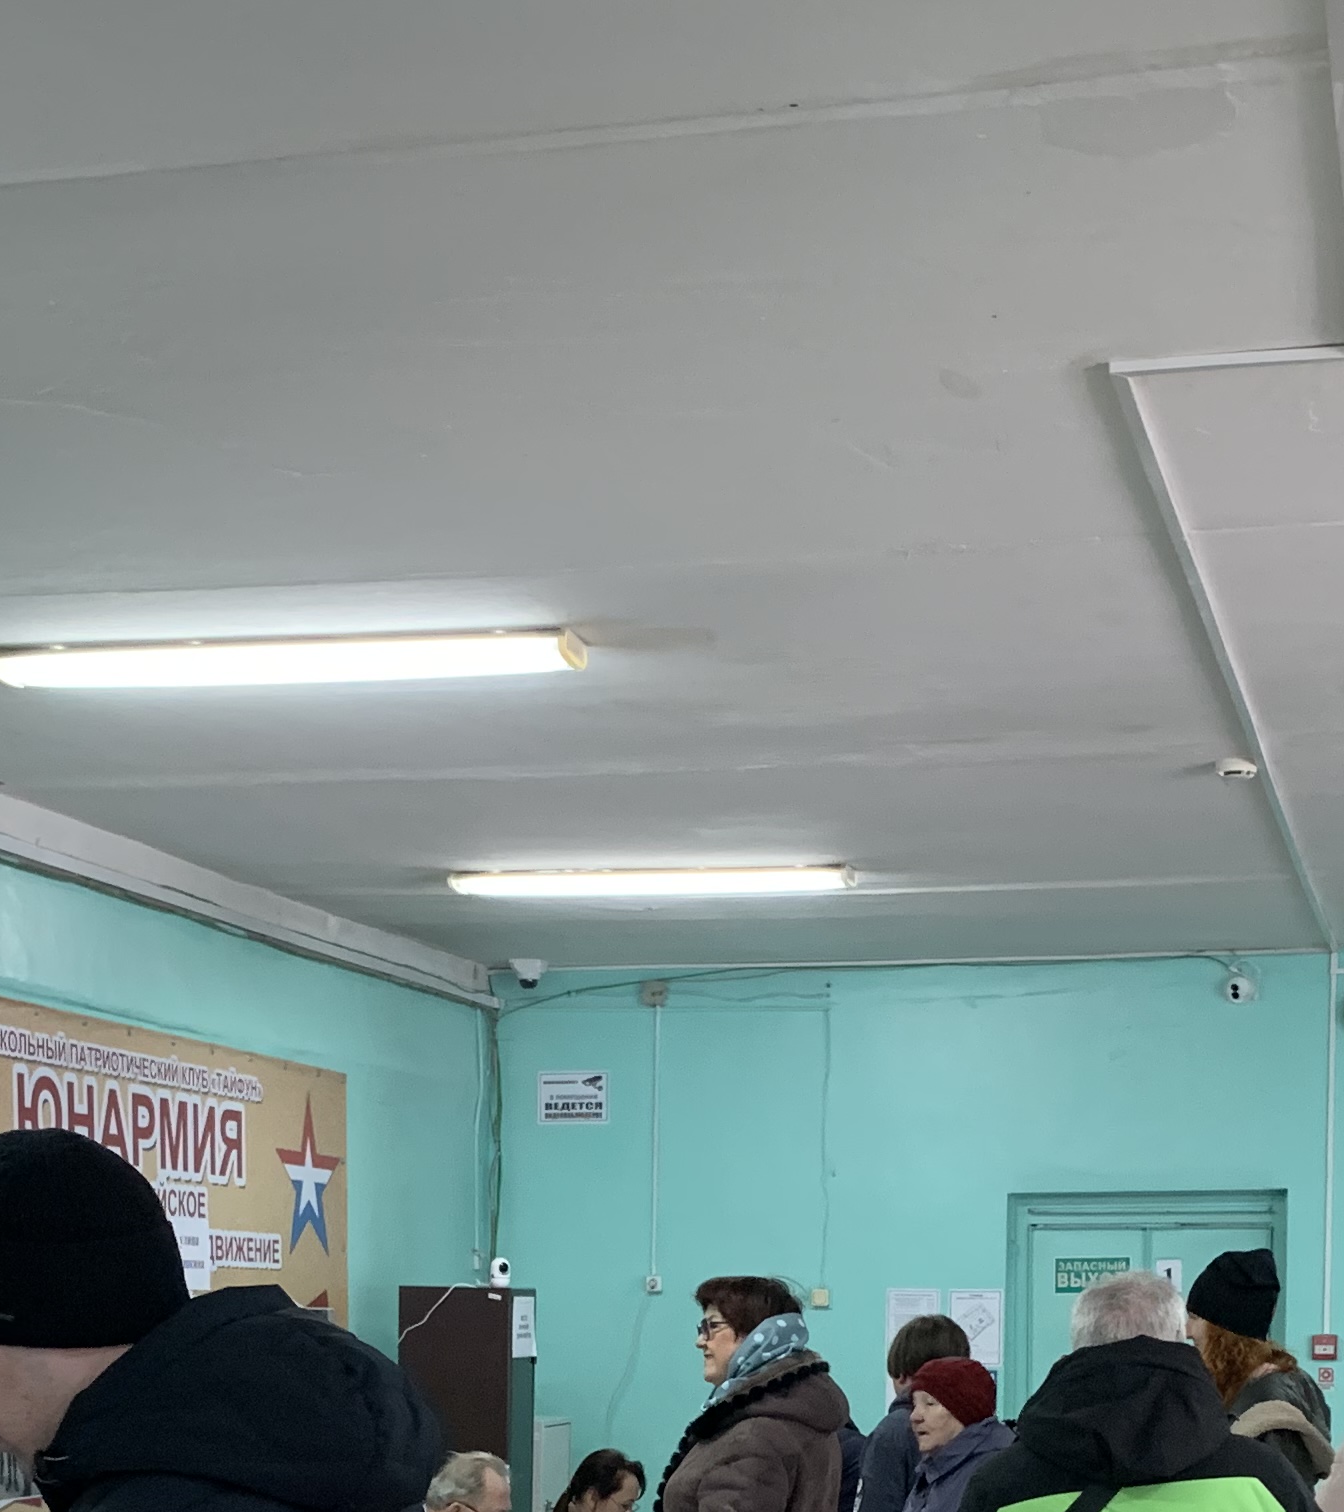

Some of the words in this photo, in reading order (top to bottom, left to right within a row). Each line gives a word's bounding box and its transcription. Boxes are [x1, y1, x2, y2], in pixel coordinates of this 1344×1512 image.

[69, 1044, 179, 1084] ПАТРИОТИЧЕСКИЙ
[181, 1065, 209, 1088] КЛУБ
[16, 1072, 244, 1179] ЮНАРМИЯ
[1057, 1260, 1127, 1272] ЗАПАСНЫЙ
